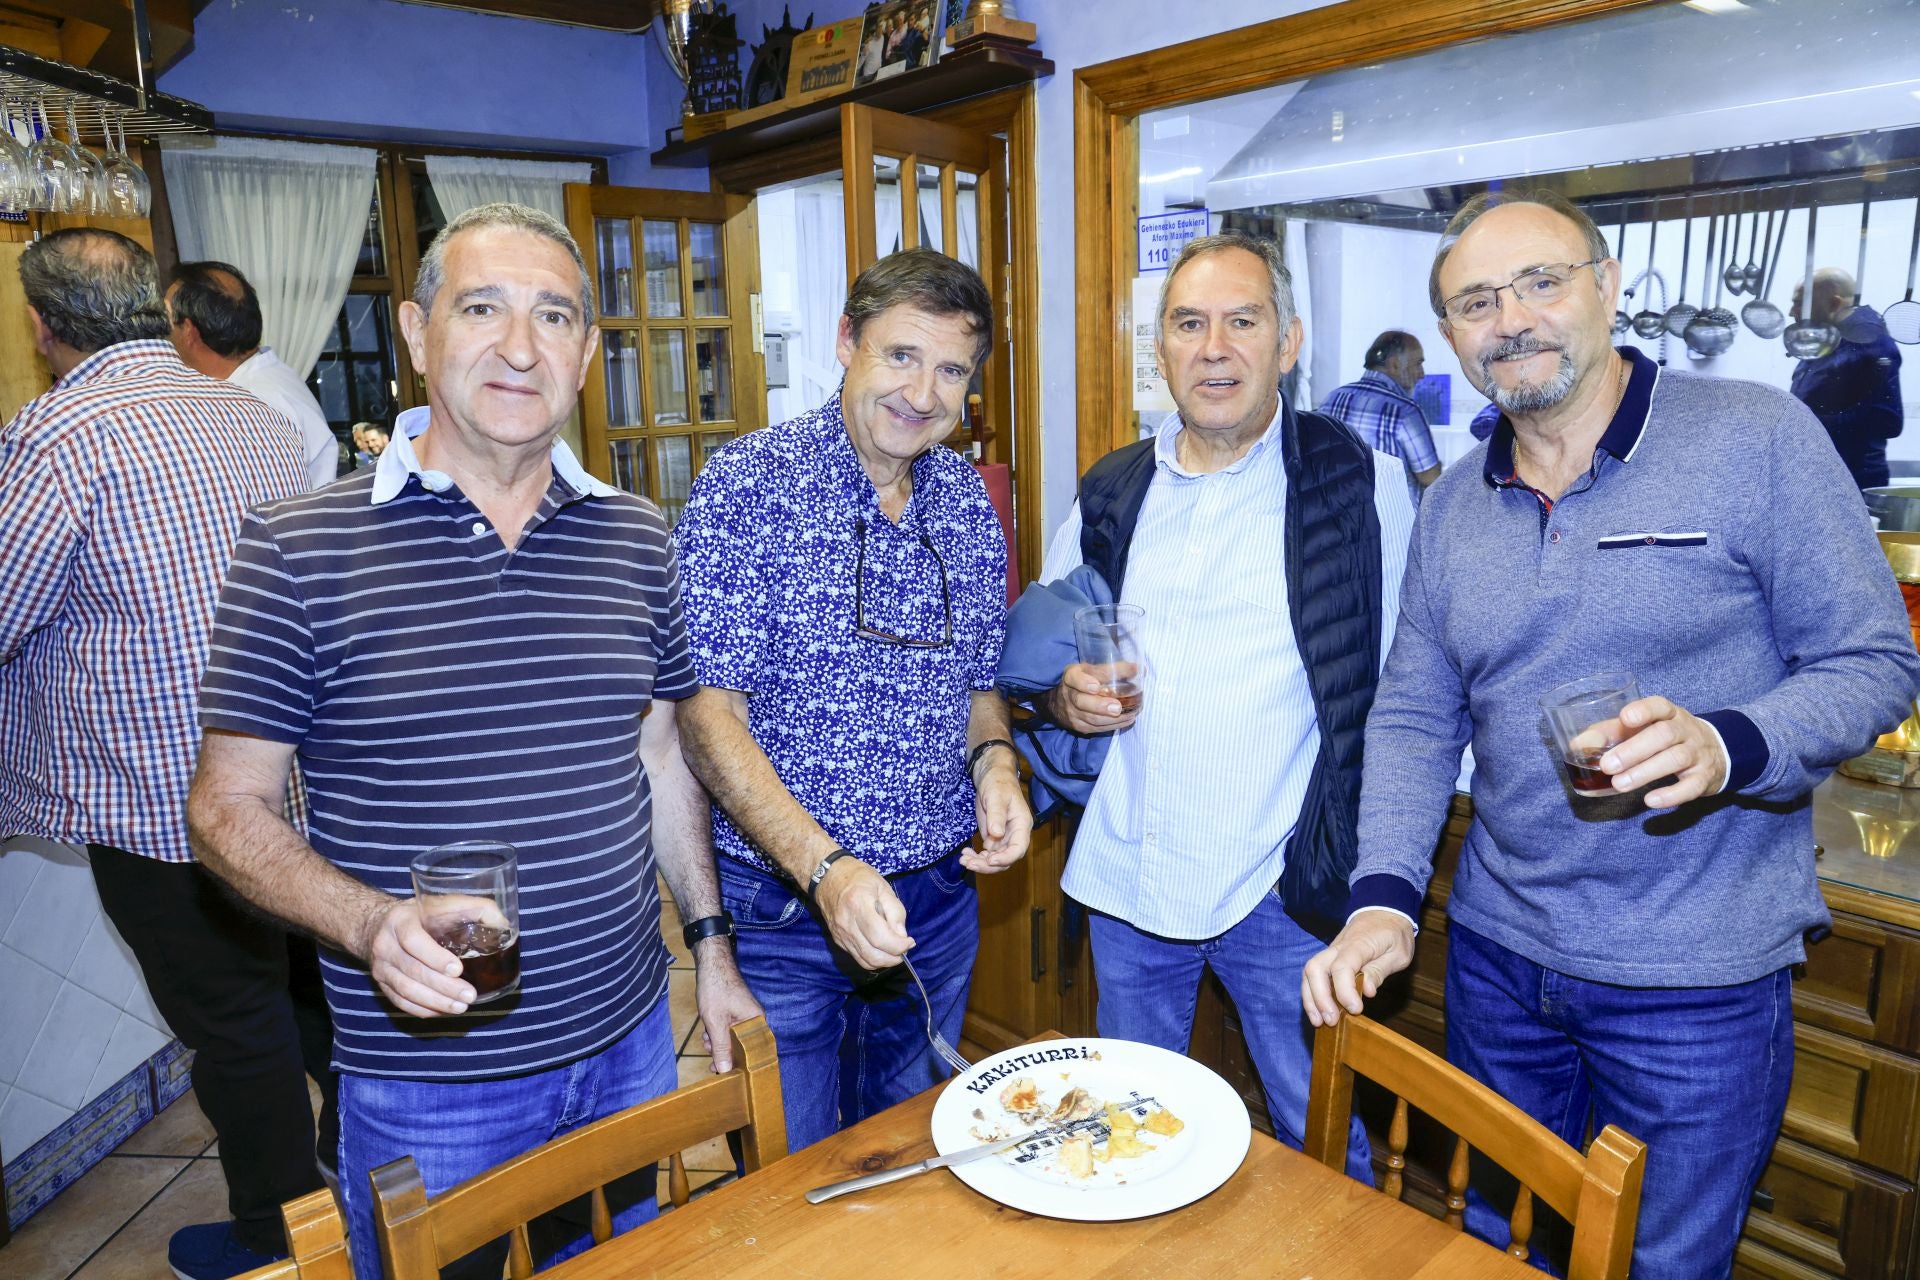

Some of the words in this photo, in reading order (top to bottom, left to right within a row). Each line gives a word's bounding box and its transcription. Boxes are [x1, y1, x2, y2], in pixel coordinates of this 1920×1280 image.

[1141, 223, 1175, 233] Gehienezko
[1177, 218, 1205, 229] Edukiera
[1152, 233, 1168, 242] Aforo
[1148, 248, 1168, 263] 110
